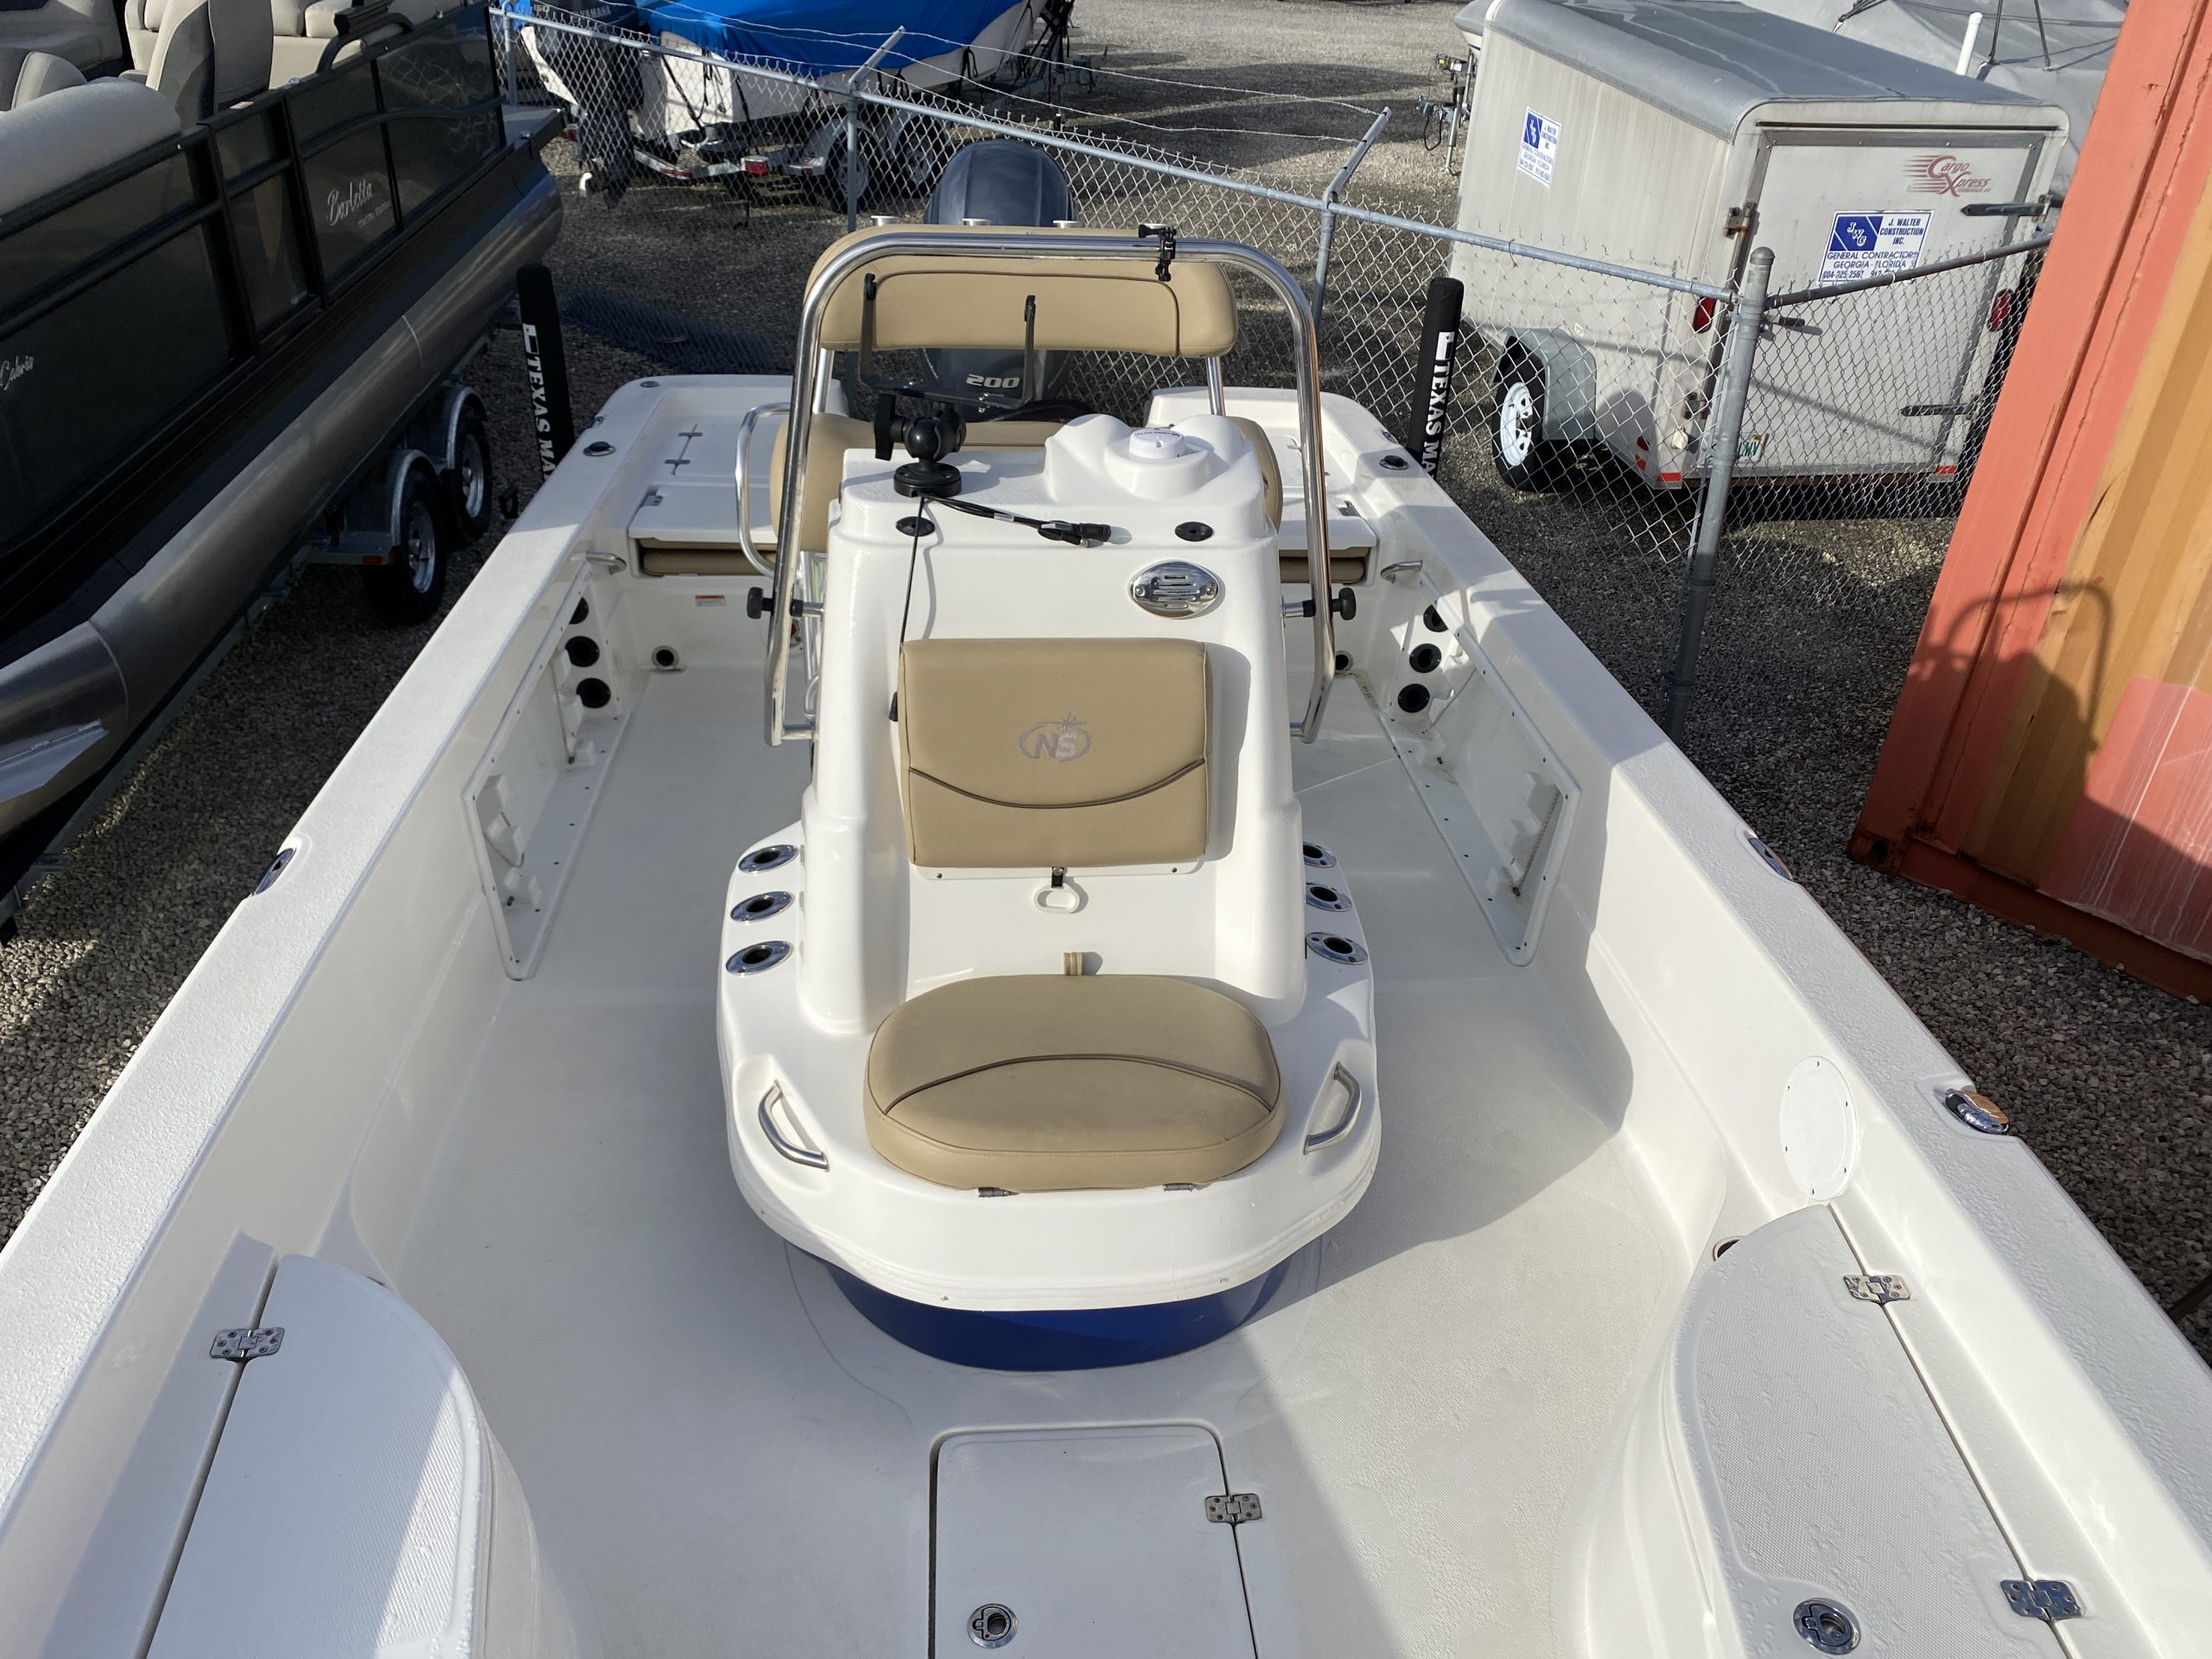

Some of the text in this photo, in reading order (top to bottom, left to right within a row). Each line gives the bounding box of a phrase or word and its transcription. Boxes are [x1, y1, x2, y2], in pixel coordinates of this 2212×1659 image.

[1928, 155, 1971, 178] Cargo
[1936, 172, 1991, 197] Xpress
[1879, 227, 1924, 236] CONSTRUCTION
[1892, 237, 1904, 245] INC.
[1827, 251, 1919, 260] GENERAL CONTRACTORS
[1833, 260, 1870, 269] GEORGIA
[966, 374, 1020, 389] 200
[527, 356, 551, 433] TEXAS
[1426, 360, 1451, 436] TEXAS
